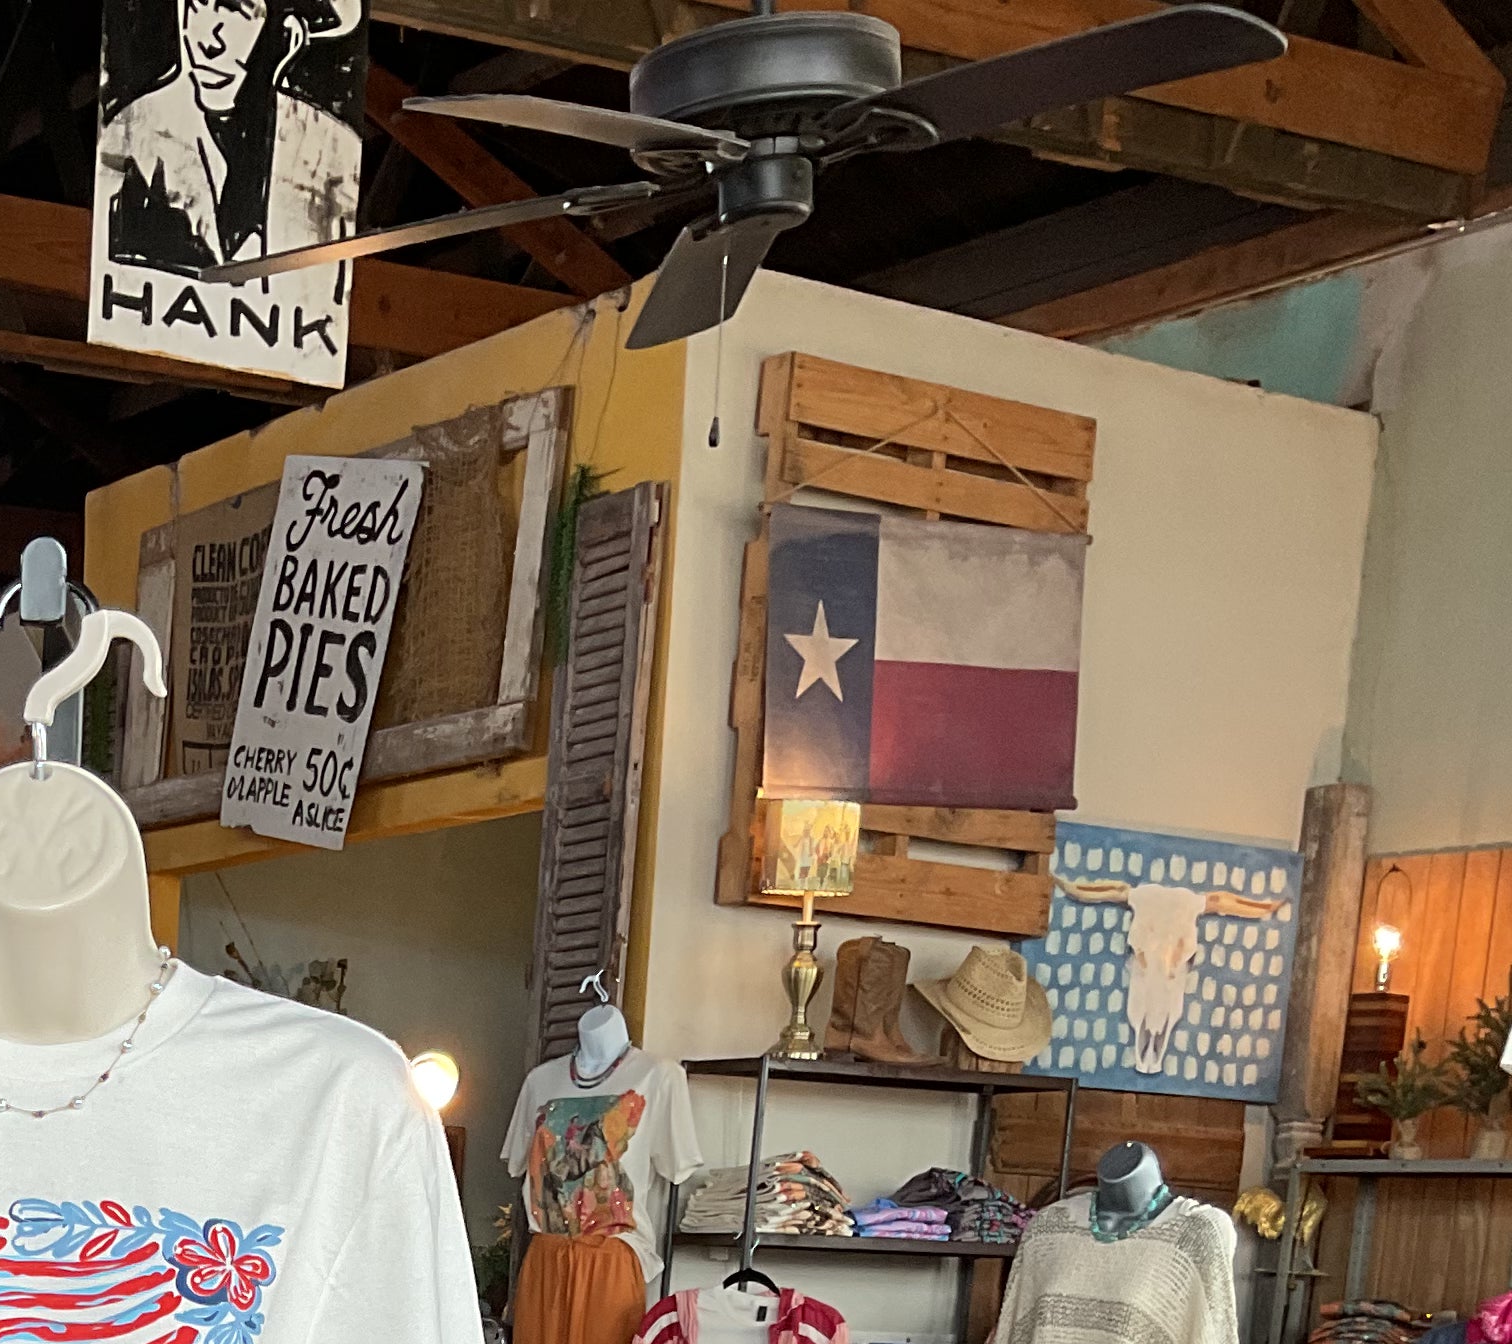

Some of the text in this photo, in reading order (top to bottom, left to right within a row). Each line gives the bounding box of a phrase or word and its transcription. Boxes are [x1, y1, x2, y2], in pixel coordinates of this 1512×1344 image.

[101, 273, 338, 357] HANK
[285, 469, 409, 552] Fresh
[272, 554, 391, 625] BAKED
[253, 618, 377, 724] PIES
[233, 744, 298, 776] CHERRY
[302, 747, 355, 800] 50¢
[245, 776, 292, 808] APPLE
[291, 799, 346, 832] A SLICE
